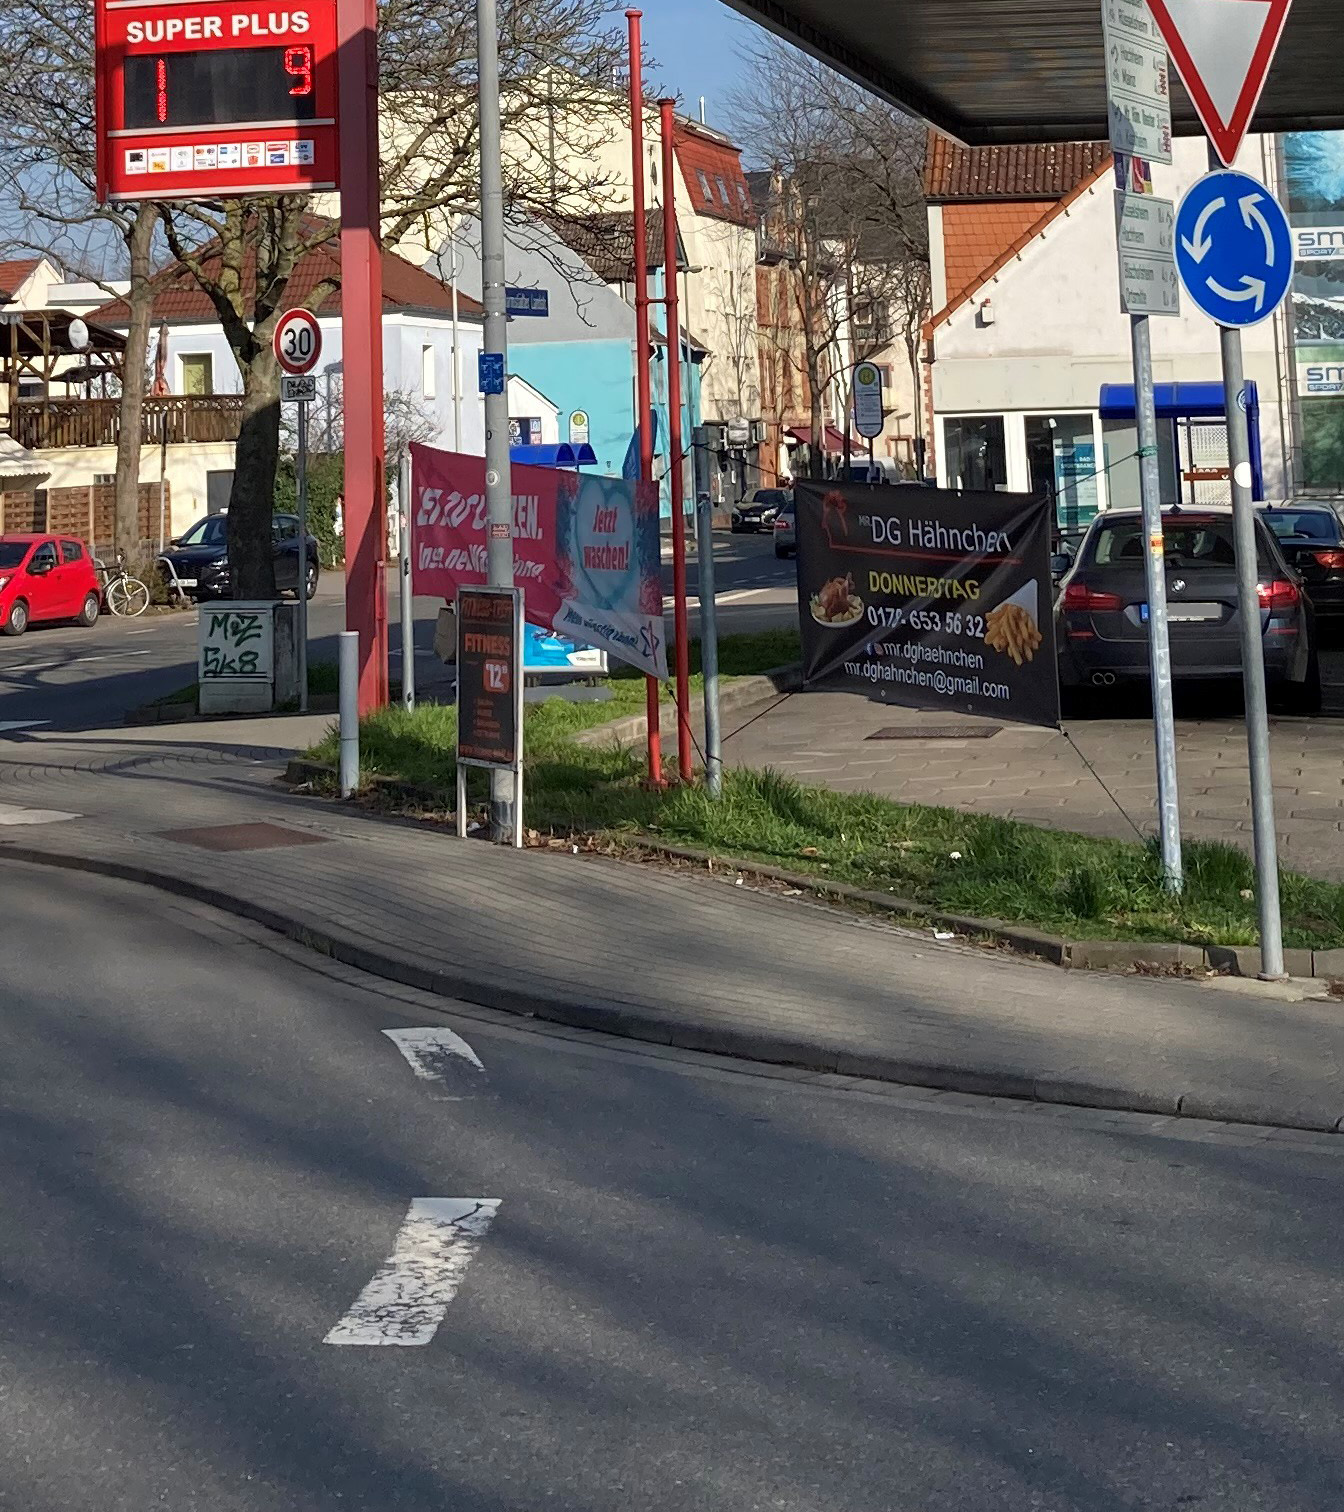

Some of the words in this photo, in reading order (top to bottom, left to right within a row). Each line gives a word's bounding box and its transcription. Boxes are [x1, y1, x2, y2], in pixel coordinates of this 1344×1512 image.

[126, 14, 224, 44] SUPER
[231, 10, 311, 37] PLUS
[1299, 248, 1333, 256] SPORT
[284, 327, 311, 357] 30
[1308, 383, 1344, 391] SPORT
[592, 505, 618, 534] Jetzt
[871, 516, 902, 546] DG
[909, 518, 1011, 553] Hähnchen
[584, 540, 630, 571] waschen!
[868, 571, 981, 601] DONNERSTAG
[909, 609, 942, 632] 653
[945, 612, 962, 635] 56
[965, 615, 985, 638] 32
[464, 633, 510, 656] FITNESS
[884, 640, 984, 670] mr.dghaehnchen
[844, 659, 1010, 701] mr.dghahnchen@gmail.com
